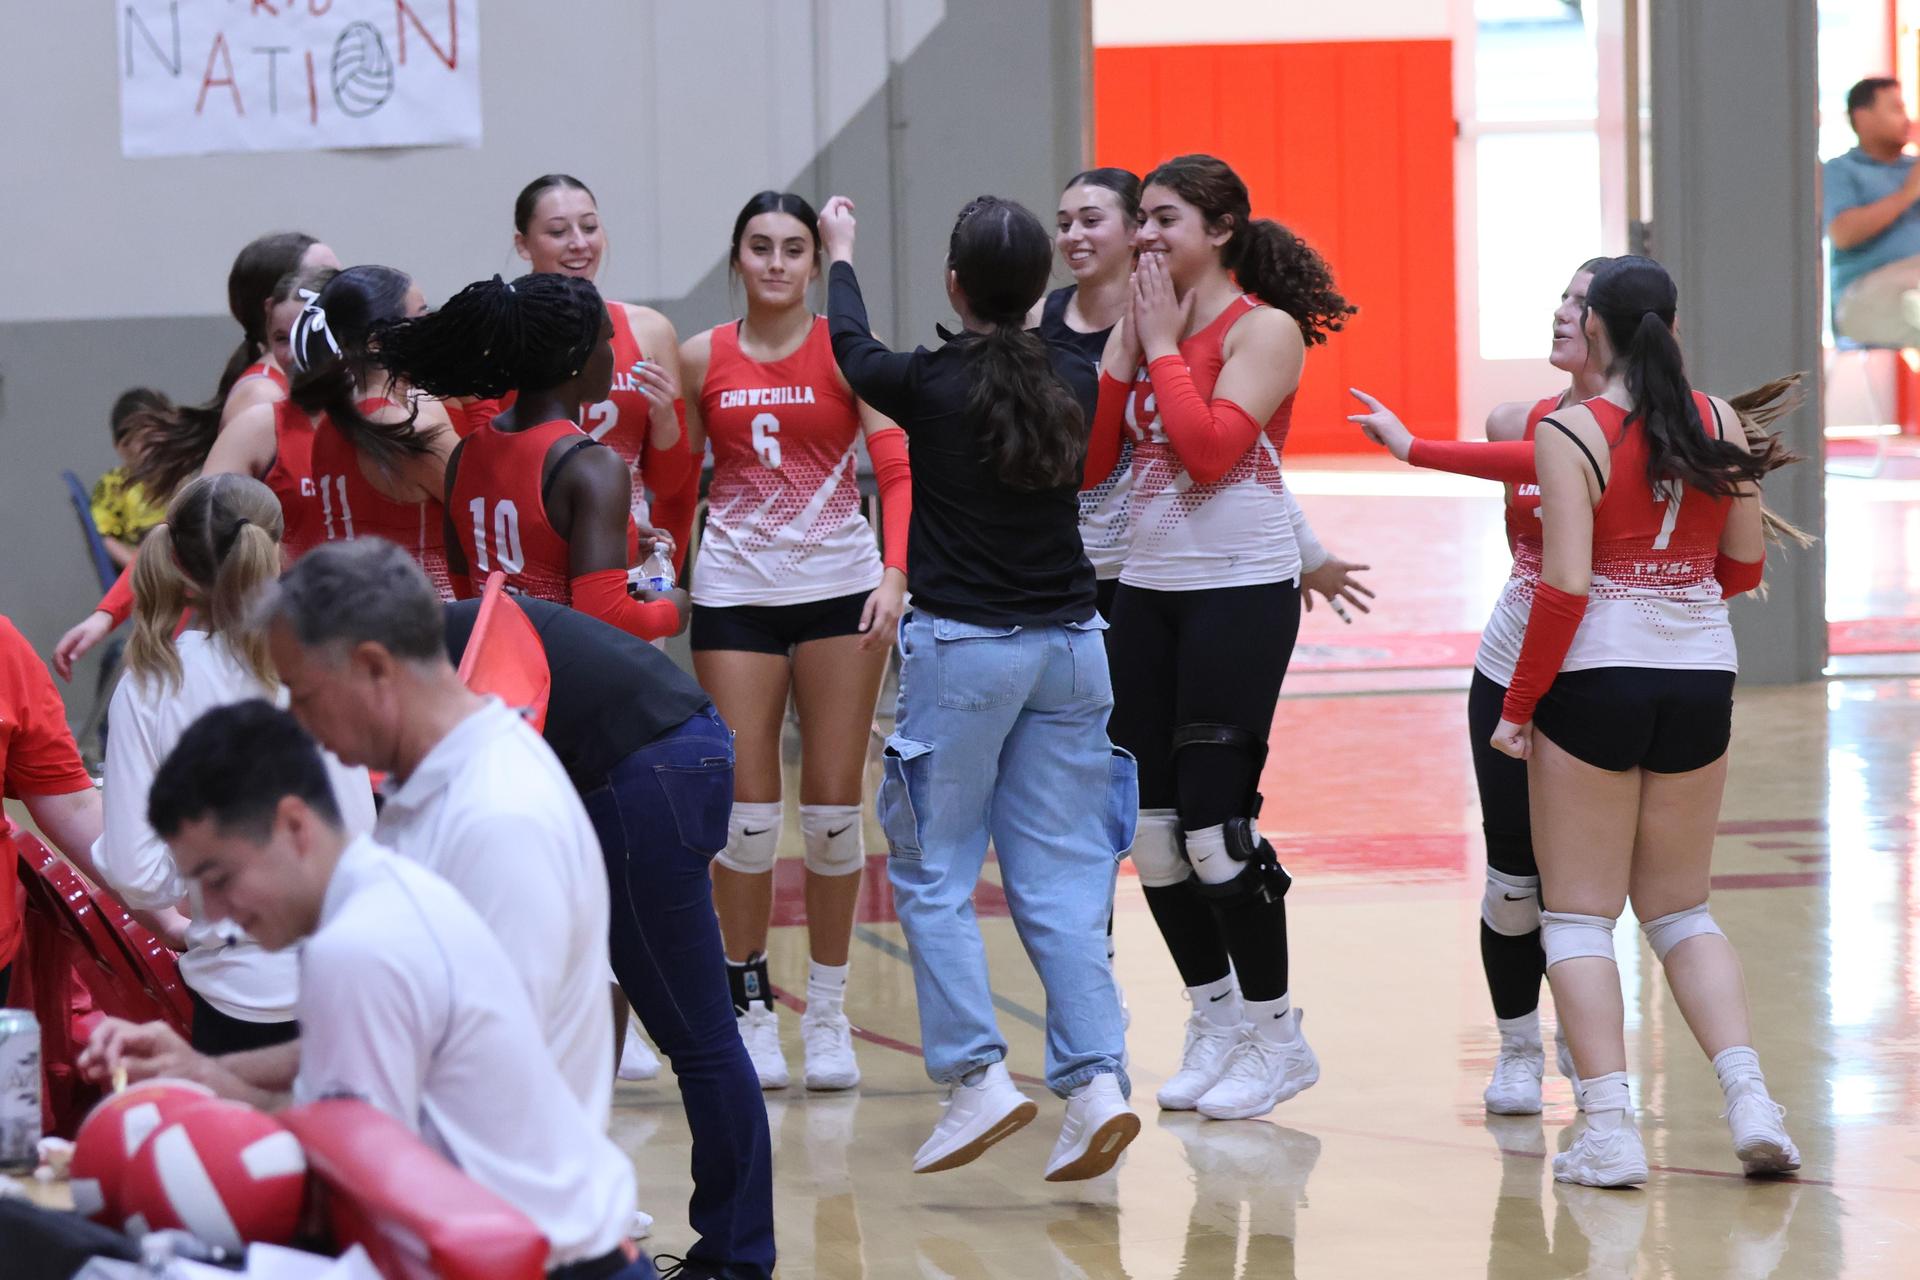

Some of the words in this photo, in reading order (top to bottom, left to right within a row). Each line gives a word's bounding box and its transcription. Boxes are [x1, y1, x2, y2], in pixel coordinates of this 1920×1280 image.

[720, 386, 816, 409] CHOWCHILLA
[751, 412, 781, 470] 6
[320, 474, 354, 541] 11
[470, 496, 525, 575] 10
[1651, 479, 1683, 550] 7
